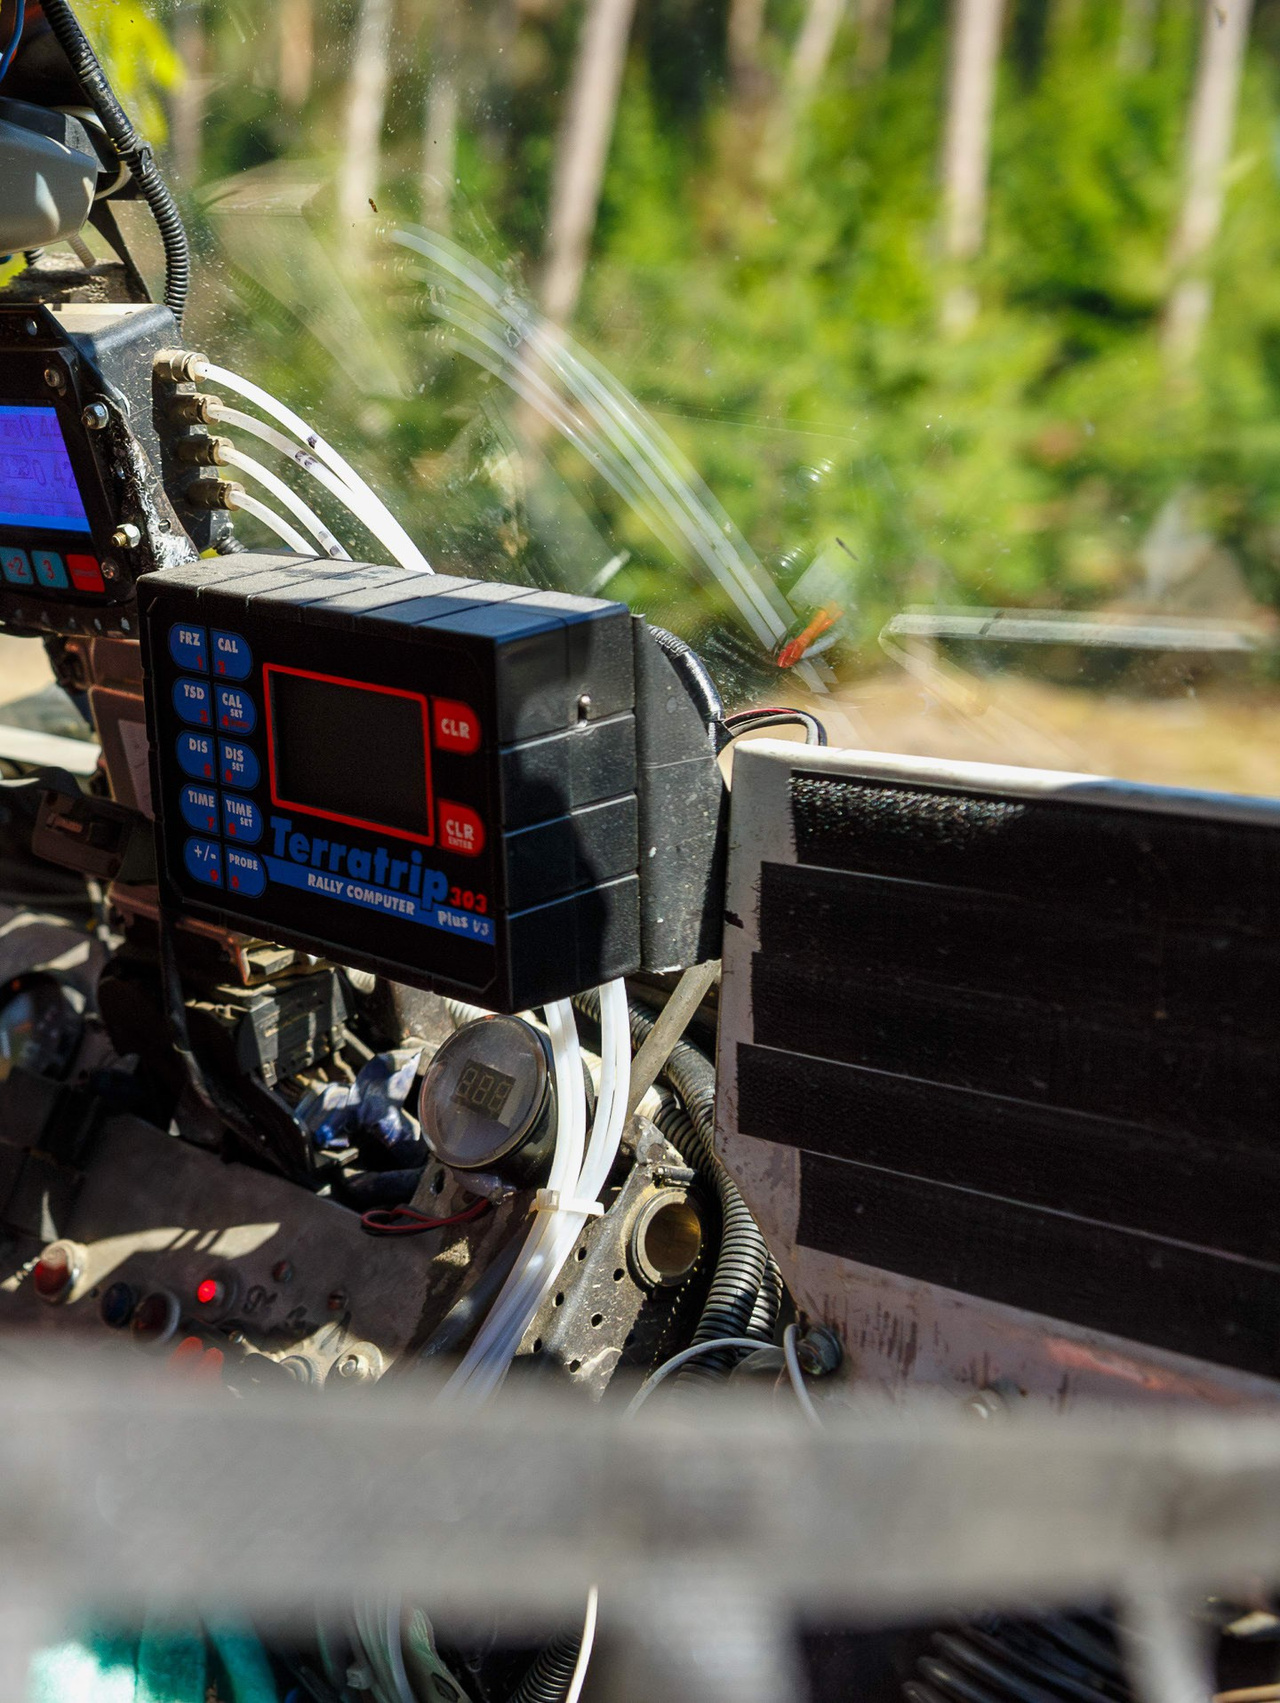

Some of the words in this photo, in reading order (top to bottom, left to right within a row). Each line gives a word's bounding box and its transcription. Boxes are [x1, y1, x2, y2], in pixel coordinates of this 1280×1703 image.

[179, 630, 200, 647] FRZ
[217, 637, 238, 654] CAL
[183, 684, 205, 700] TSD
[221, 692, 242, 709] CAL
[230, 708, 243, 719] SET
[441, 718, 470, 740] CLR
[188, 737, 208, 754] DIS
[224, 746, 244, 762] DIS
[231, 761, 244, 772] SET
[188, 790, 215, 808] TIME
[226, 799, 252, 818] TIME
[239, 816, 253, 828] SET
[446, 819, 474, 841] CLR
[447, 835, 473, 850] ENTER
[229, 853, 258, 871] PROBE
[270, 815, 449, 912] Terratrip
[450, 887, 487, 914] 303
[307, 873, 344, 895] RALLY
[346, 884, 416, 916] COMPUTER
